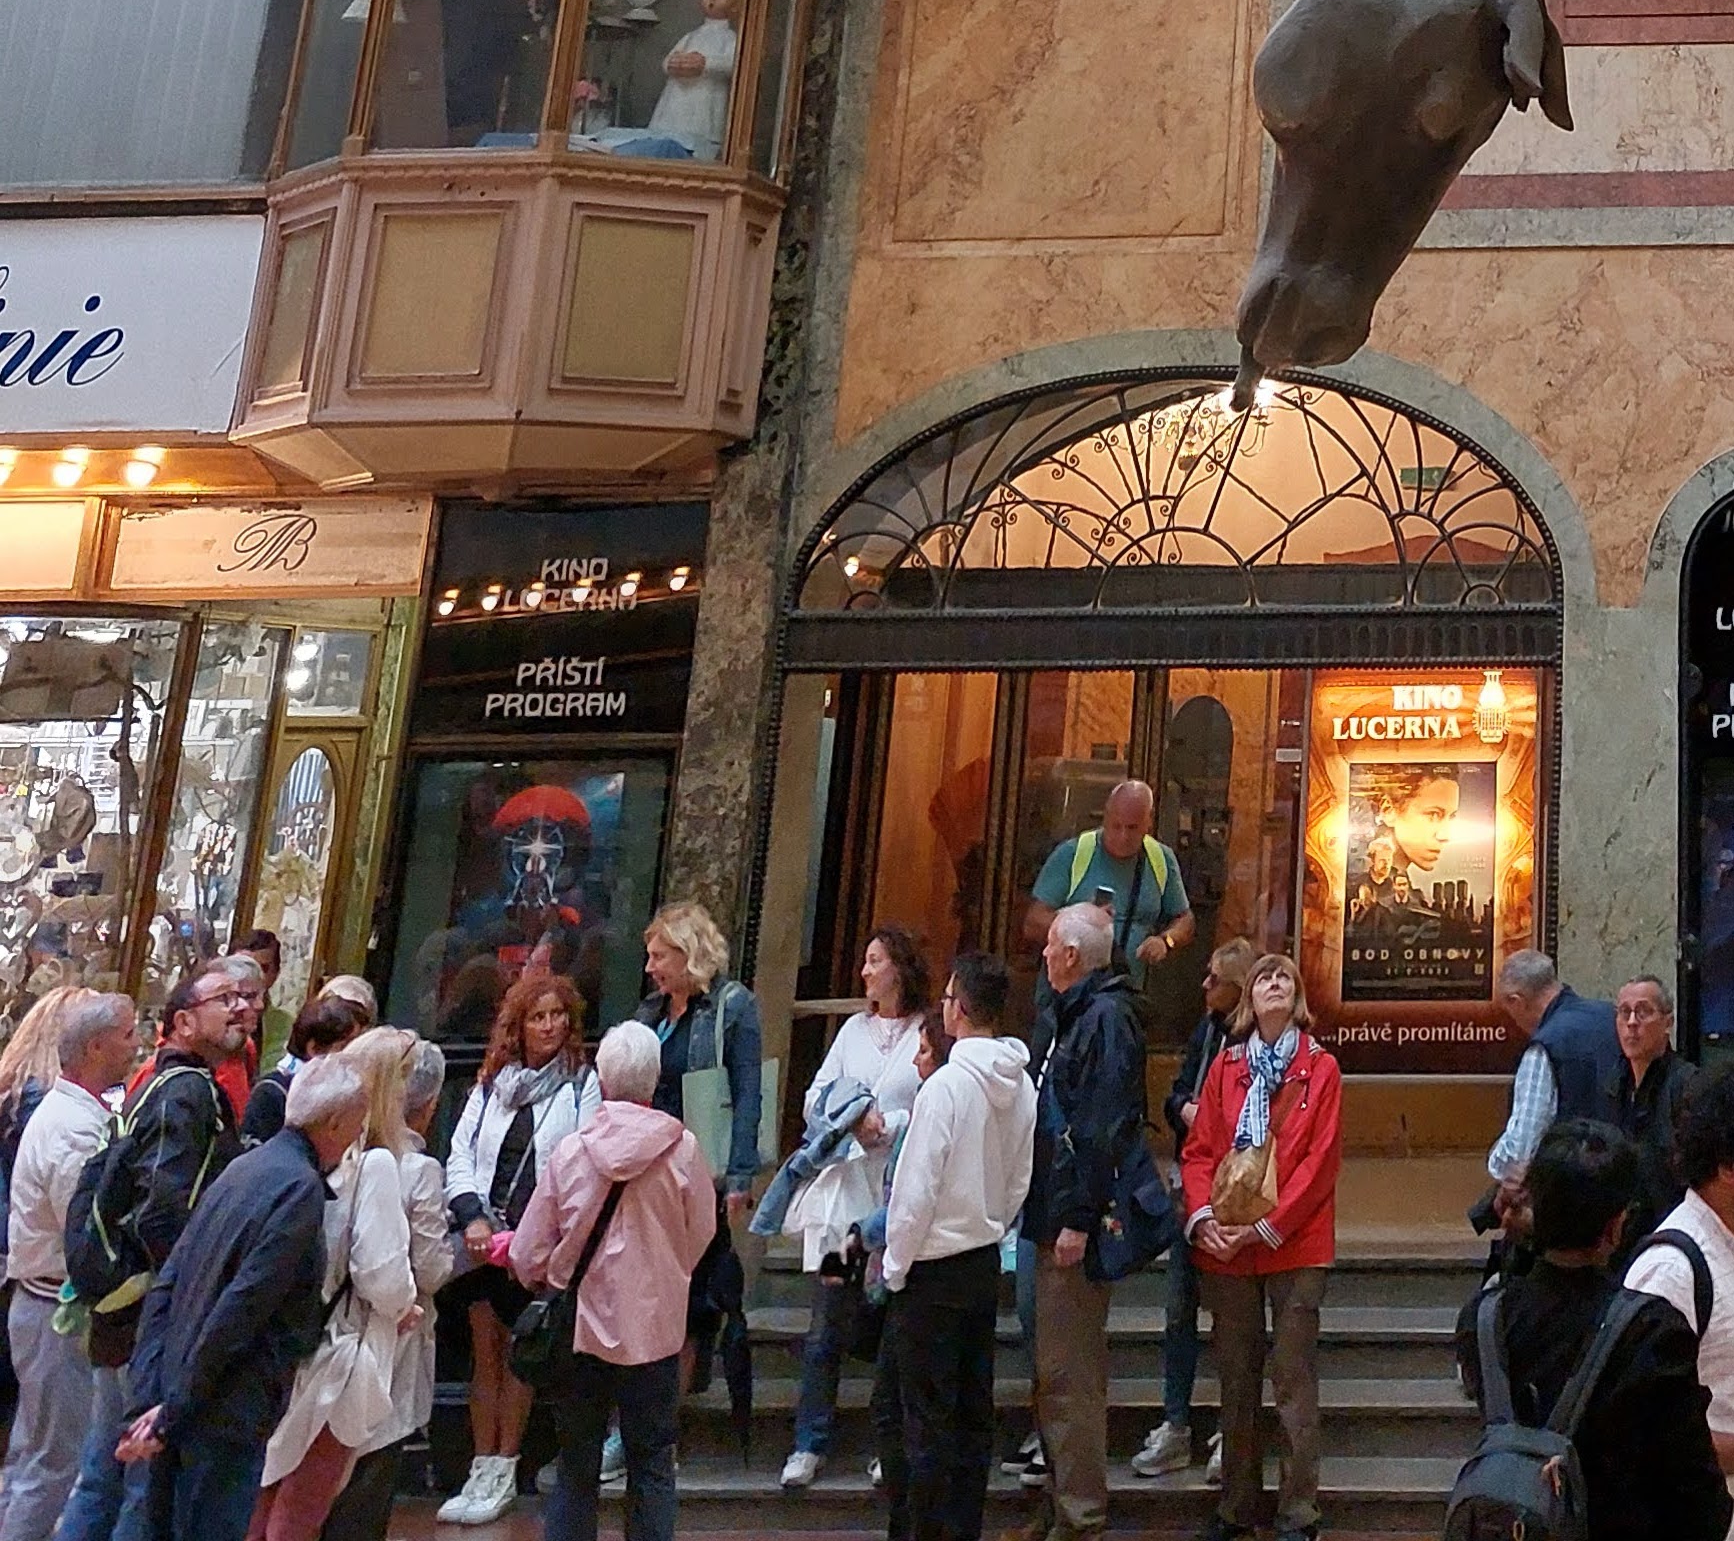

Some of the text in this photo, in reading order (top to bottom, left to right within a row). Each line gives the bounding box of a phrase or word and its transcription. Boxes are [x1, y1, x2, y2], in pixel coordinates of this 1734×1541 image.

[540, 557, 609, 582] KINO
[515, 656, 606, 687] PŘÍŠTÍ
[484, 691, 626, 718] PROGRAM
[1391, 685, 1463, 710] KINO
[1332, 716, 1462, 740] LUCERNA
[1351, 947, 1485, 961] BOD OBNOVY
[1397, 1021, 1507, 1046] promítáme
